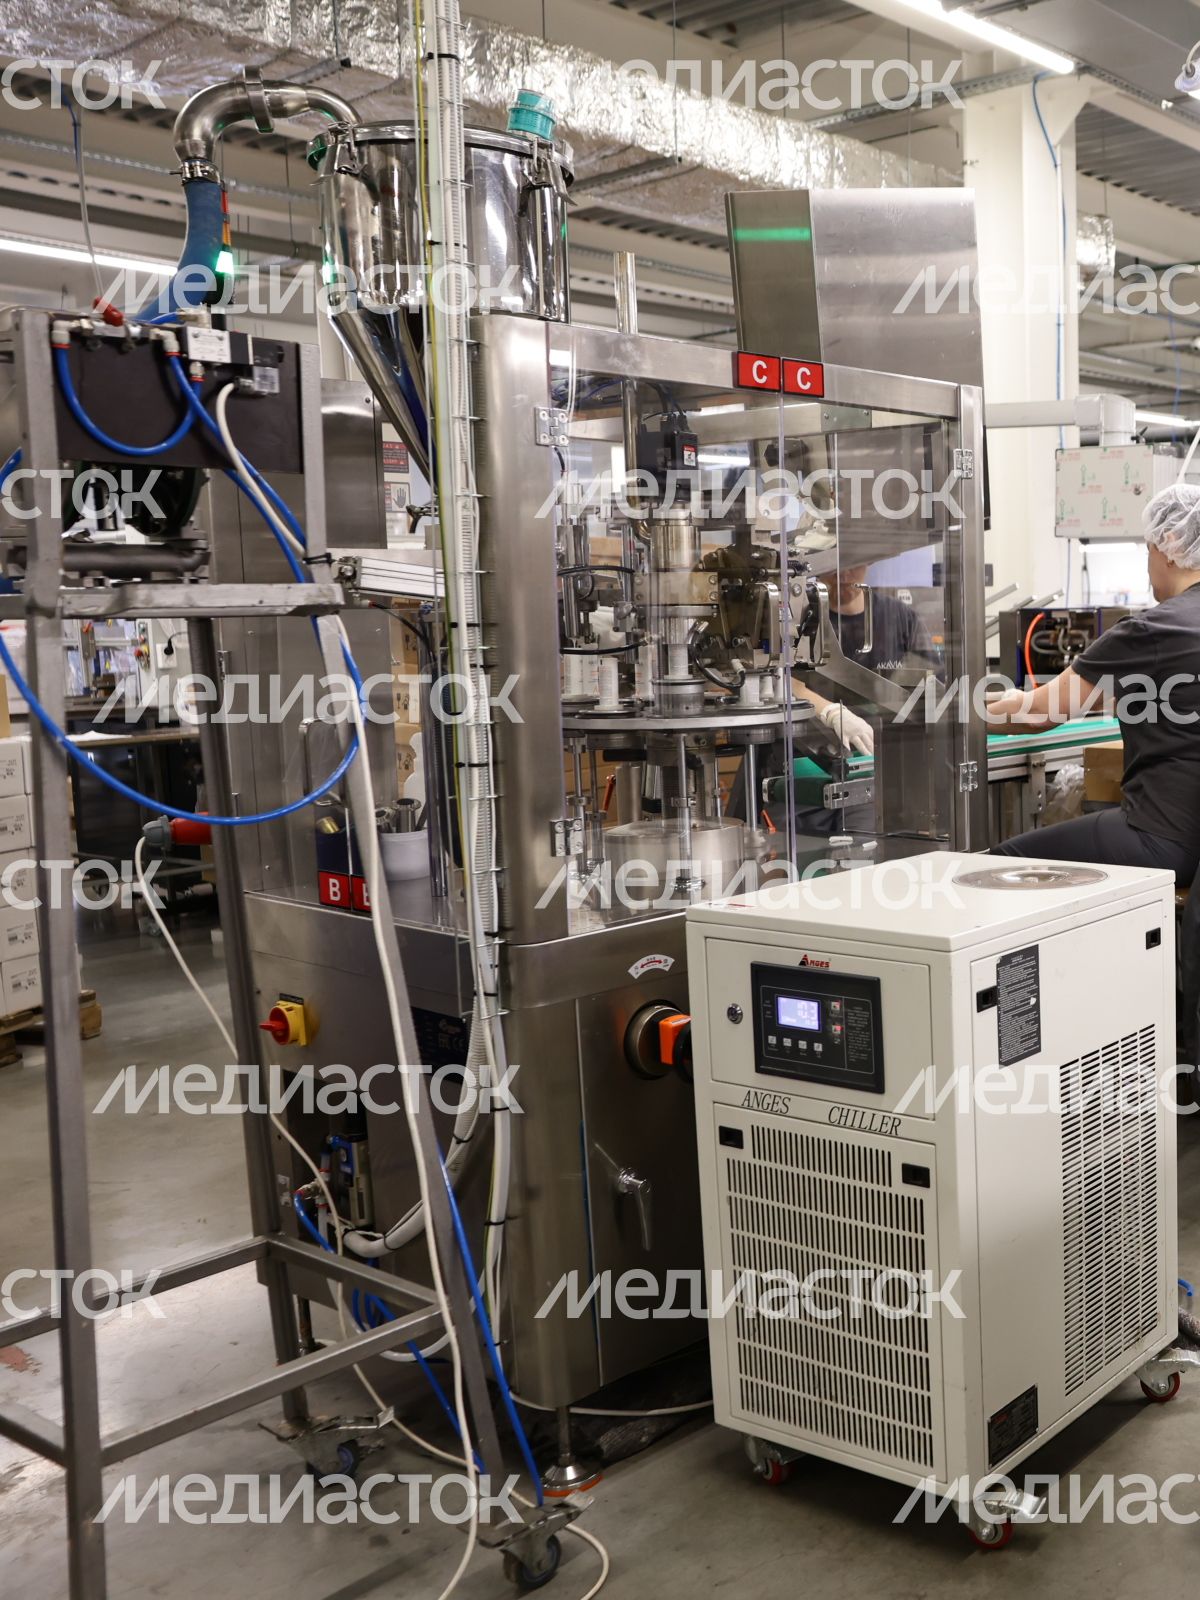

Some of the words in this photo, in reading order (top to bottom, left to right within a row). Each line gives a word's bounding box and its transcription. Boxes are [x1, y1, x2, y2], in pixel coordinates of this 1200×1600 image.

[752, 360, 768, 384] C
[797, 367, 811, 390] C
[329, 878, 341, 901] B
[740, 1089, 791, 1115] ANGES
[828, 1105, 902, 1136] CHILLER
